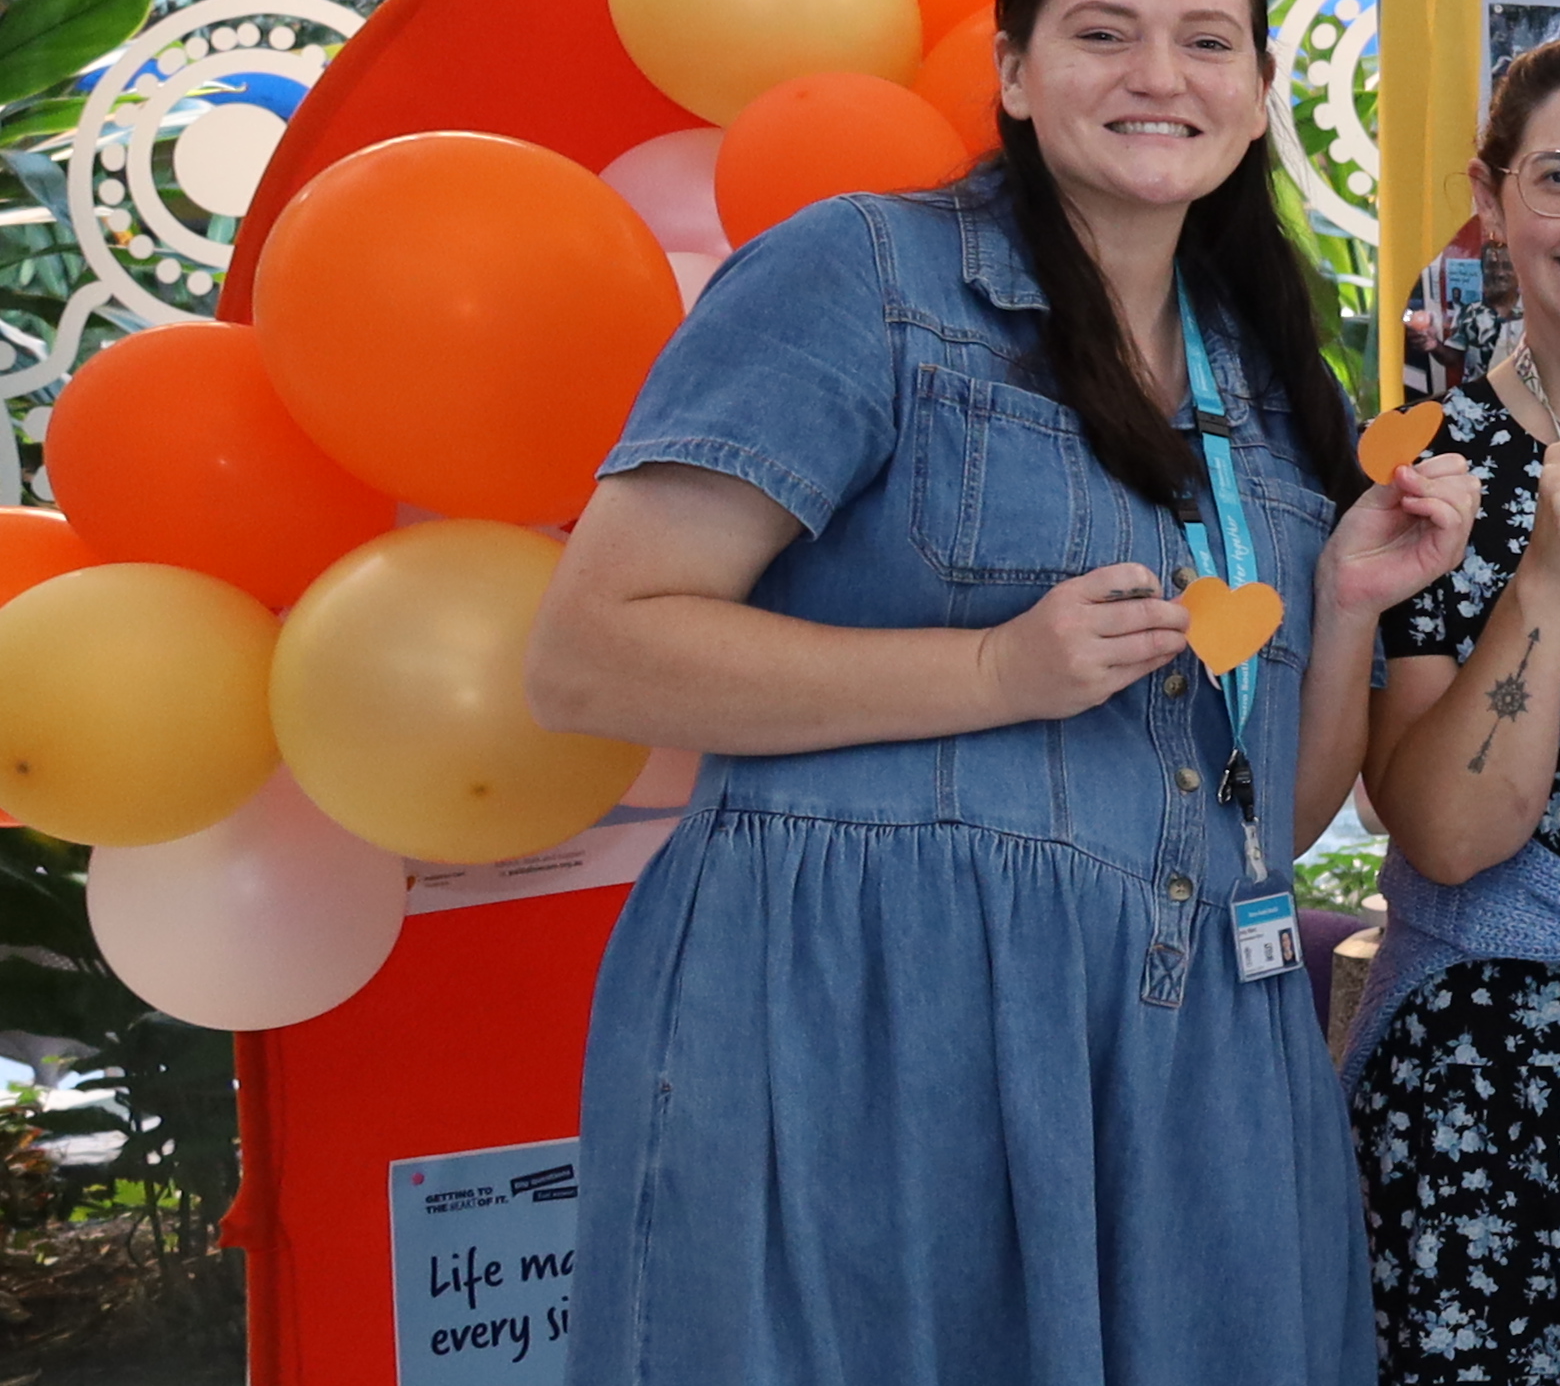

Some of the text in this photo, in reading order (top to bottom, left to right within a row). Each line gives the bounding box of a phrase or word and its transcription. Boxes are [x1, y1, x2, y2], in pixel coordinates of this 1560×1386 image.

[425, 1186, 493, 1204] GETTING TO
[425, 1203, 449, 1214] THE
[478, 1197, 492, 1207] OF
[429, 1245, 503, 1310] Life
[430, 1315, 530, 1363] every
